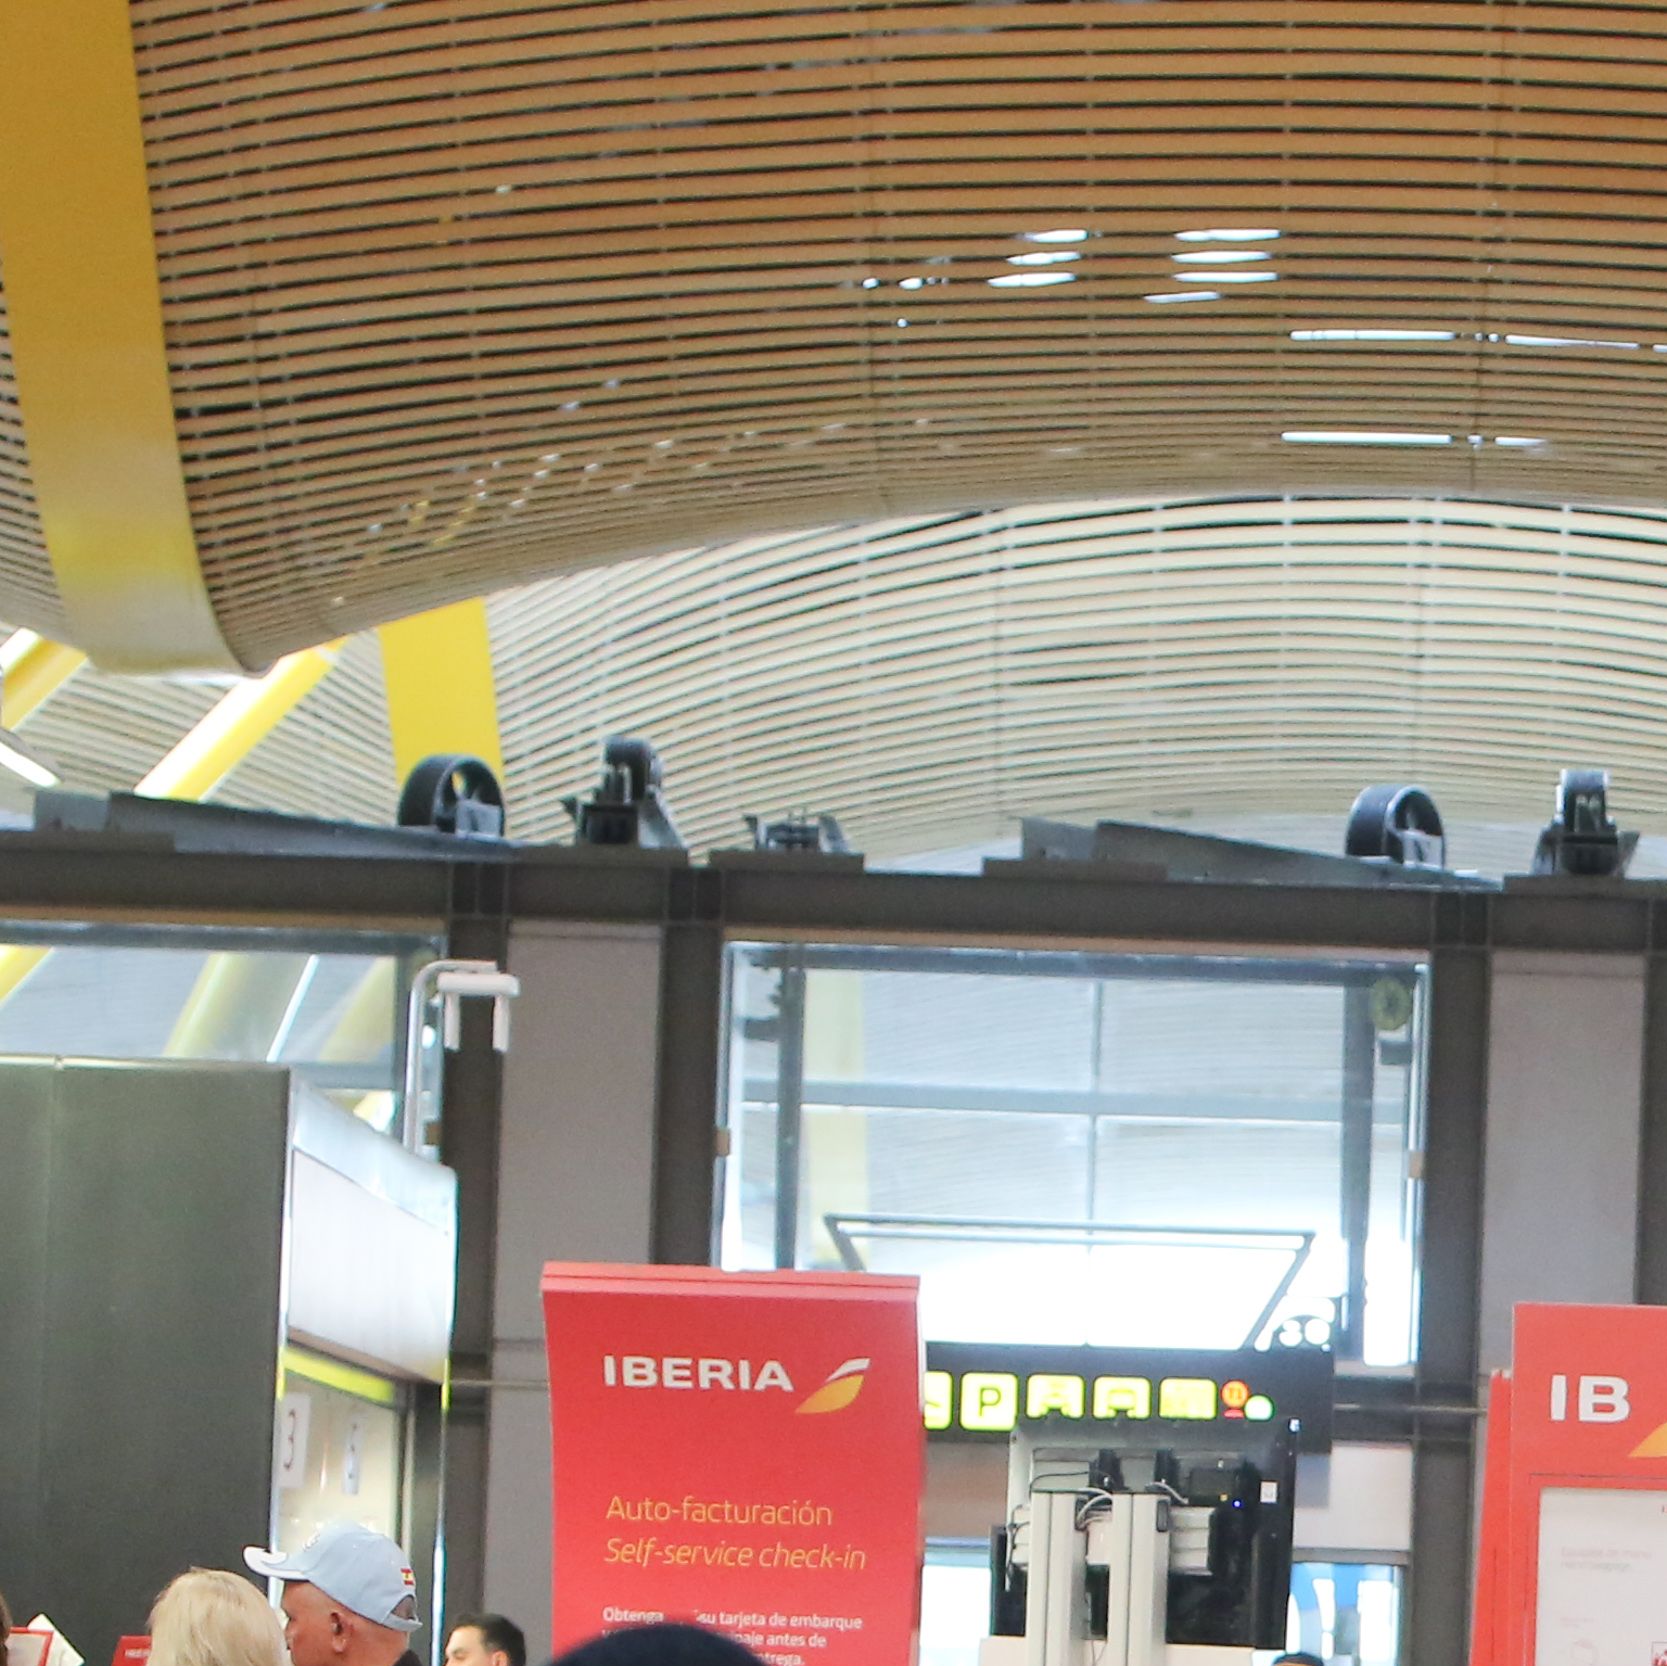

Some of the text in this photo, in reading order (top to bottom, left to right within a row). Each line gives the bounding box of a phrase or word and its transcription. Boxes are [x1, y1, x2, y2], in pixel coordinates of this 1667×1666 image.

[603, 1355, 795, 1392] IBERIA
[1550, 1374, 1630, 1423] IB
[605, 1496, 833, 1527] Auto-facturación
[604, 1538, 866, 1570] Self-service check-in
[602, 1607, 664, 1625] Obtenga
[719, 1612, 766, 1628] tarjeta
[769, 1613, 788, 1627] de
[789, 1614, 863, 1633] embarque
[766, 1633, 806, 1648] antes
[808, 1633, 827, 1648] de
